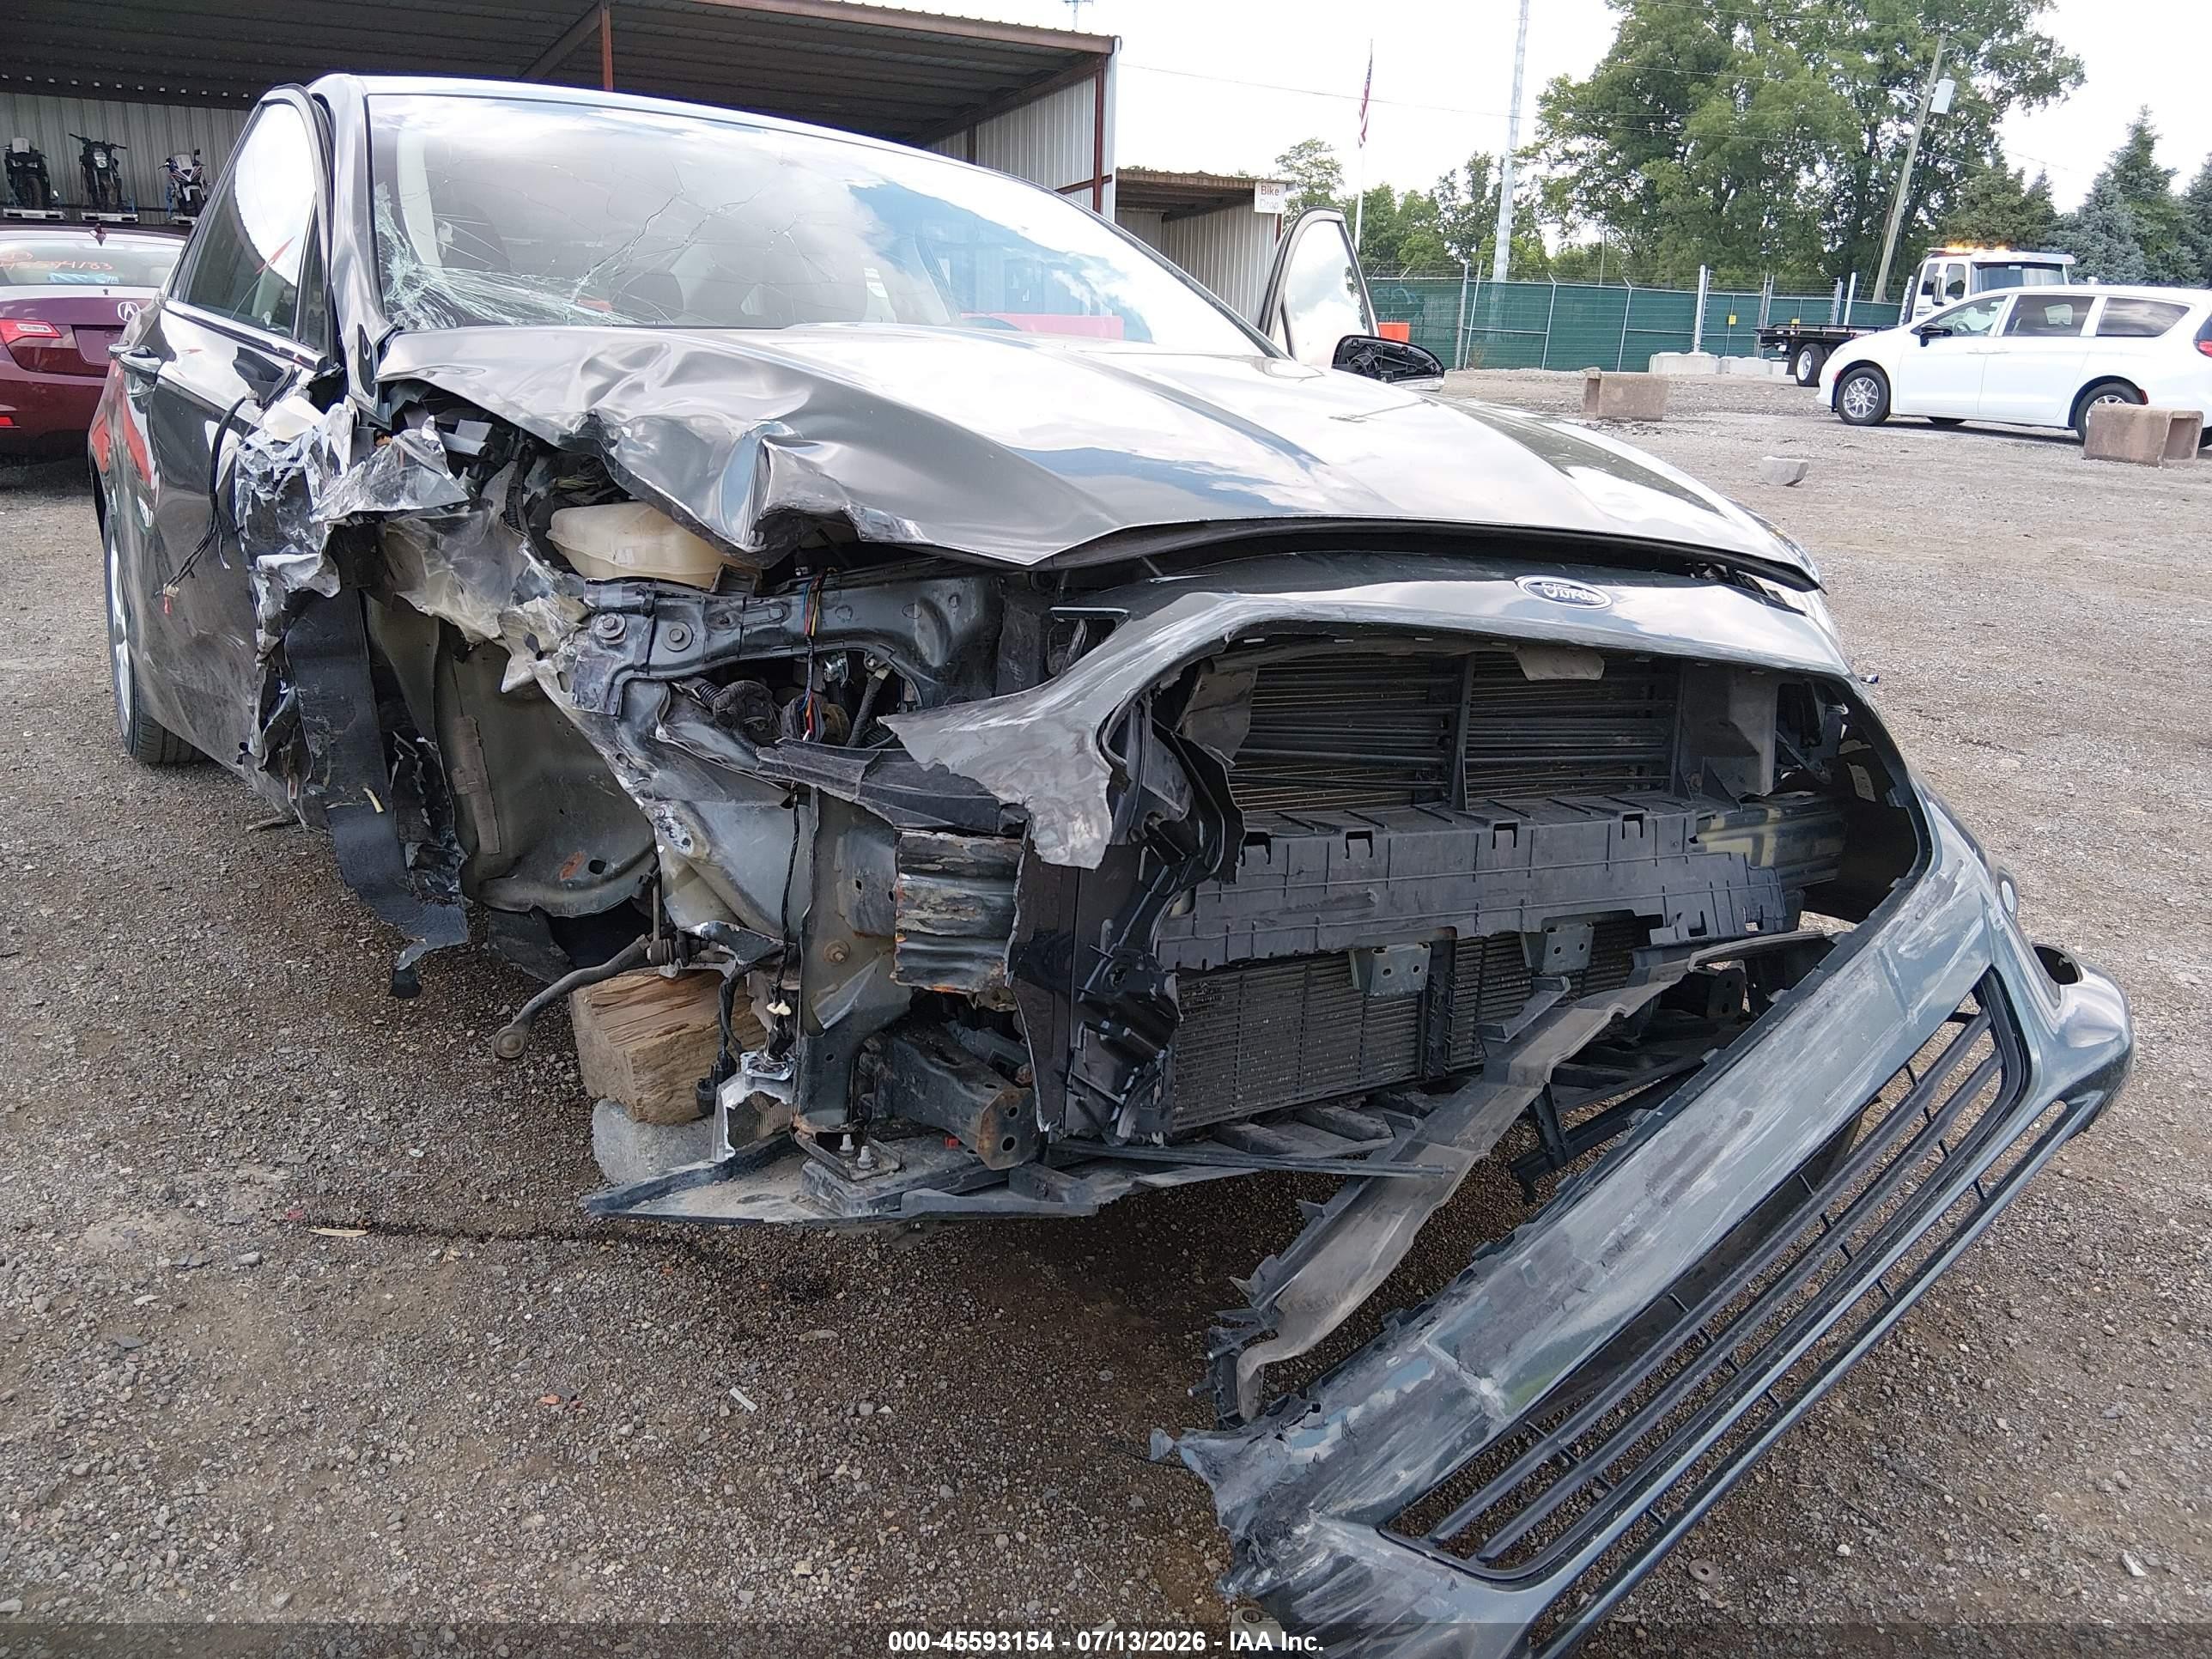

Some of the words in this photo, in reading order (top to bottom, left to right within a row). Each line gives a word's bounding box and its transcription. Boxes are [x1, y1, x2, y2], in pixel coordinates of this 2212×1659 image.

[1261, 185, 1279, 196] Bike
[1260, 199, 1279, 209] Drop
[1541, 581, 1599, 602] Ford
